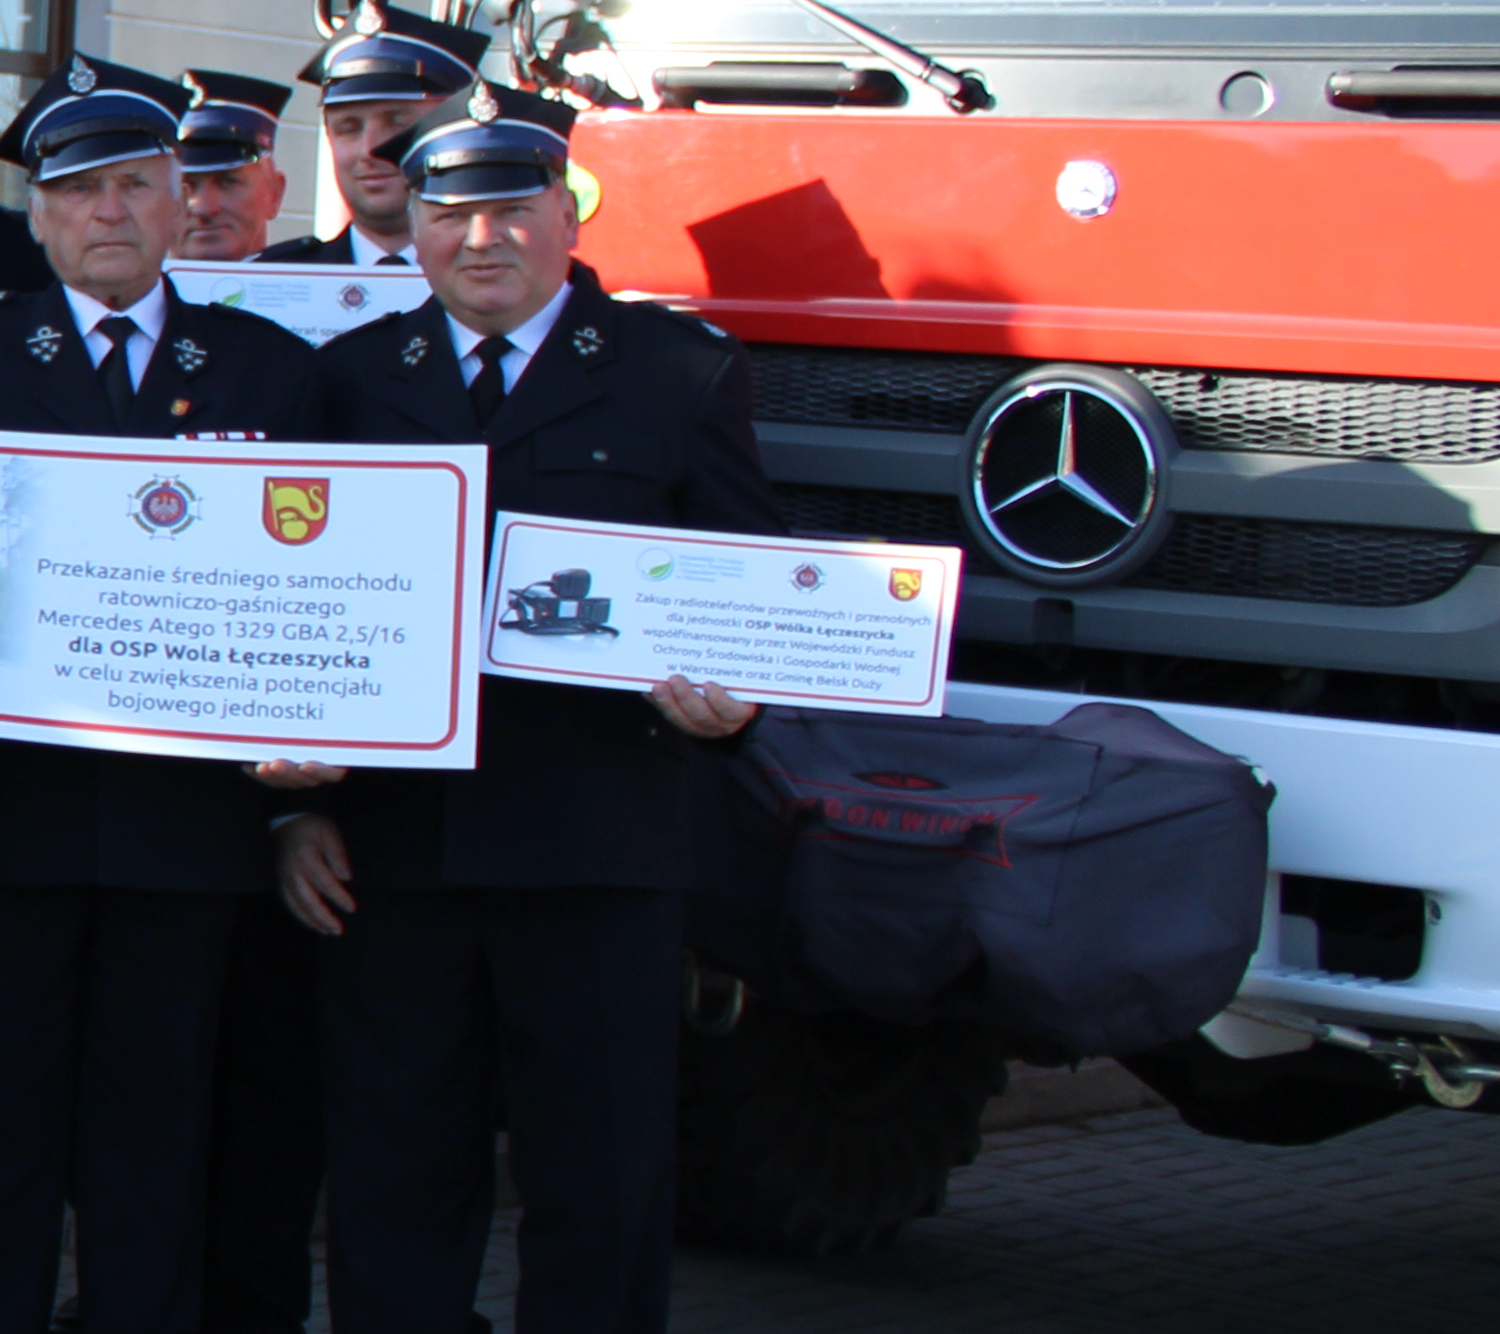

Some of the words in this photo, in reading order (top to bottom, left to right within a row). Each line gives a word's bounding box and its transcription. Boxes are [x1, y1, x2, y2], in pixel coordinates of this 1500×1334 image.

[36, 559, 166, 582] Przekazanie
[171, 564, 280, 590] średniego
[285, 572, 411, 593] samochodu
[98, 590, 346, 620] ratowniczo-gaśniczego
[634, 593, 672, 607] Zakup
[673, 597, 767, 613] radiotelefonów
[849, 610, 854, 621] i
[855, 613, 930, 628] przenośnych
[37, 610, 144, 633] Mercedes
[148, 616, 216, 639] Atego
[223, 619, 276, 639] 1329
[282, 622, 330, 642] GBA
[335, 625, 405, 648] 2,5/16
[666, 611, 685, 623] dla
[685, 613, 743, 628] jednostki
[744, 619, 772, 630] OSP
[774, 621, 814, 634] Wólka
[67, 636, 101, 655] dla
[109, 640, 159, 658] OSP
[164, 643, 222, 662] Wola
[227, 646, 369, 671] Łęczeszycka
[641, 628, 753, 647] współfinansowany
[754, 638, 788, 649] przez
[790, 639, 863, 655] Wojewódzki
[864, 645, 915, 659] Fundusz
[651, 644, 704, 660] Ochrony
[705, 646, 774, 664] Środowiska
[776, 654, 781, 665] i
[783, 655, 852, 671] Gospodarki
[853, 661, 901, 677] Wodnej
[665, 663, 678, 672] w
[679, 662, 744, 678] Warszawie
[745, 670, 773, 681] oraz
[774, 671, 814, 686] Gminę
[816, 675, 850, 687] Belsk
[851, 678, 883, 692] Duży
[53, 665, 73, 679] w
[77, 663, 123, 683] celu
[128, 667, 258, 691] zwiększenia
[265, 676, 380, 699] potencjału
[107, 689, 217, 717] bojowego
[219, 697, 324, 721] jednostki
